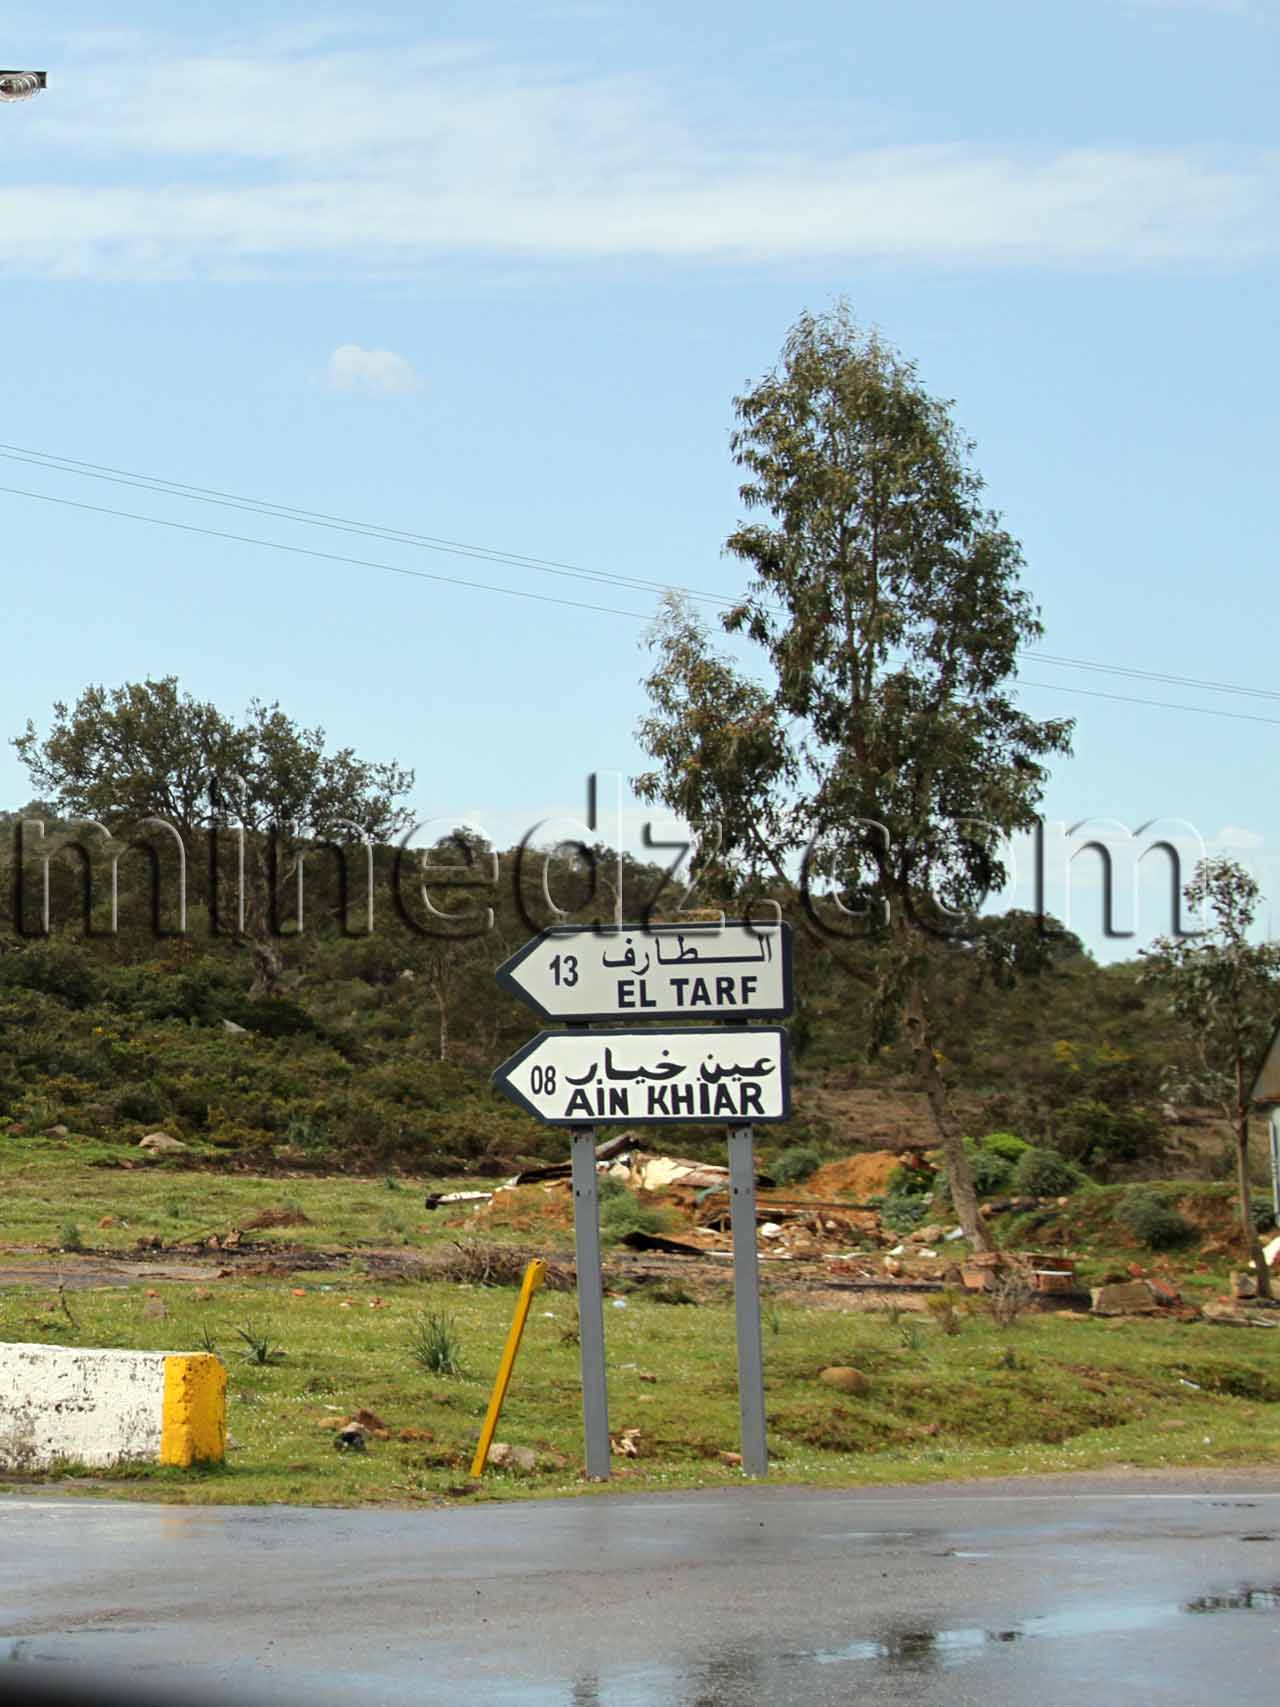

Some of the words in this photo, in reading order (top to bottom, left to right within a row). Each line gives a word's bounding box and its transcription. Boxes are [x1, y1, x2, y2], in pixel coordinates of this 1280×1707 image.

[549, 954, 579, 987] 13
[617, 979, 657, 1008] EL
[670, 976, 758, 1006] TARF
[530, 1065, 557, 1096] 08
[564, 1047, 687, 1085] خيار
[700, 1053, 776, 1084] عين
